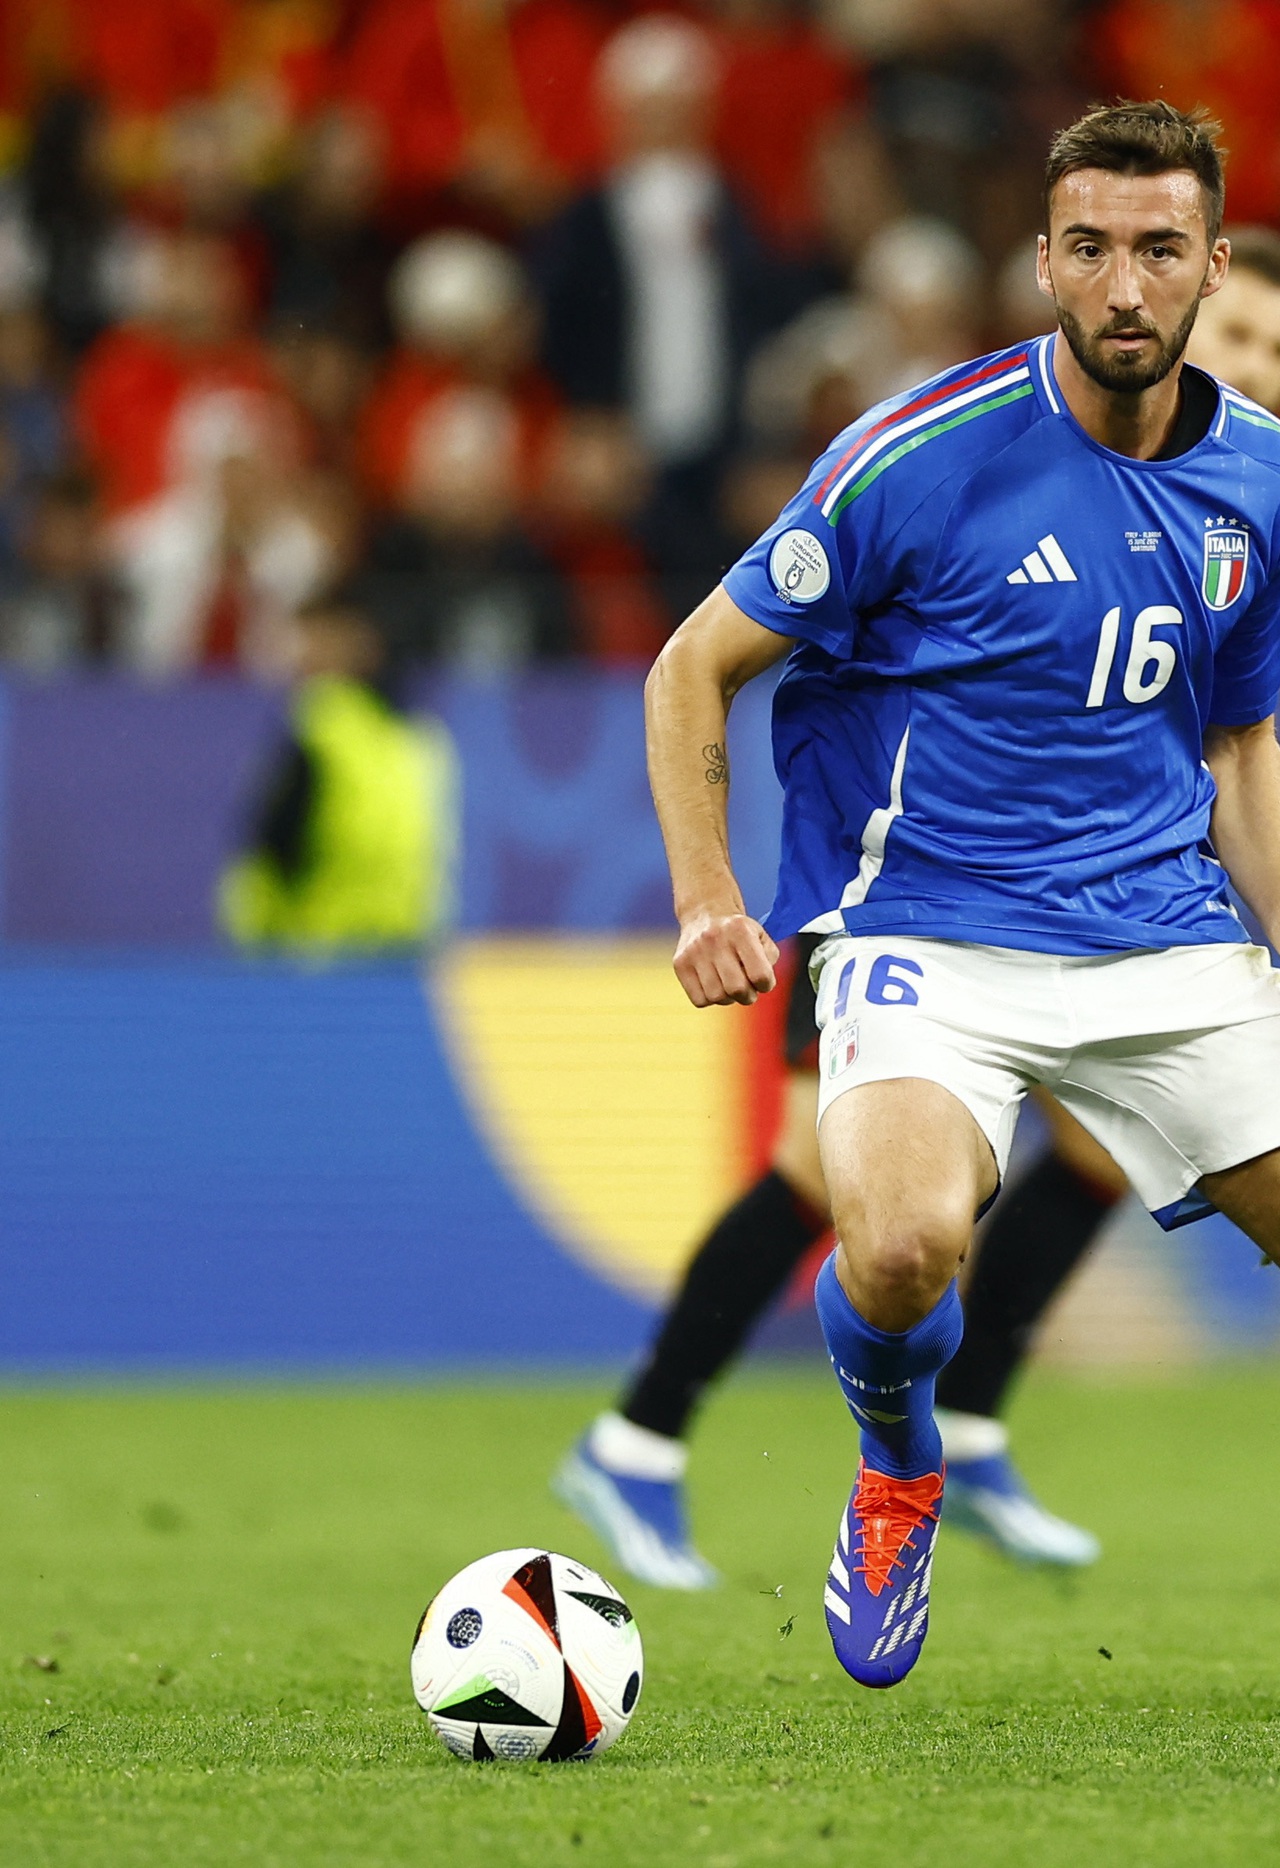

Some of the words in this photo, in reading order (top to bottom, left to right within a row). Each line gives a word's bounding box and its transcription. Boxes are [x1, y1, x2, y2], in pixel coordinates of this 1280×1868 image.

[789, 545, 819, 574] CHAMPIONS
[792, 538, 822, 568] EUROPEAN
[1208, 536, 1245, 553] ITALIA
[1085, 604, 1184, 708] 16
[833, 953, 925, 1020] 16
[831, 1354, 913, 1395] ALIA
